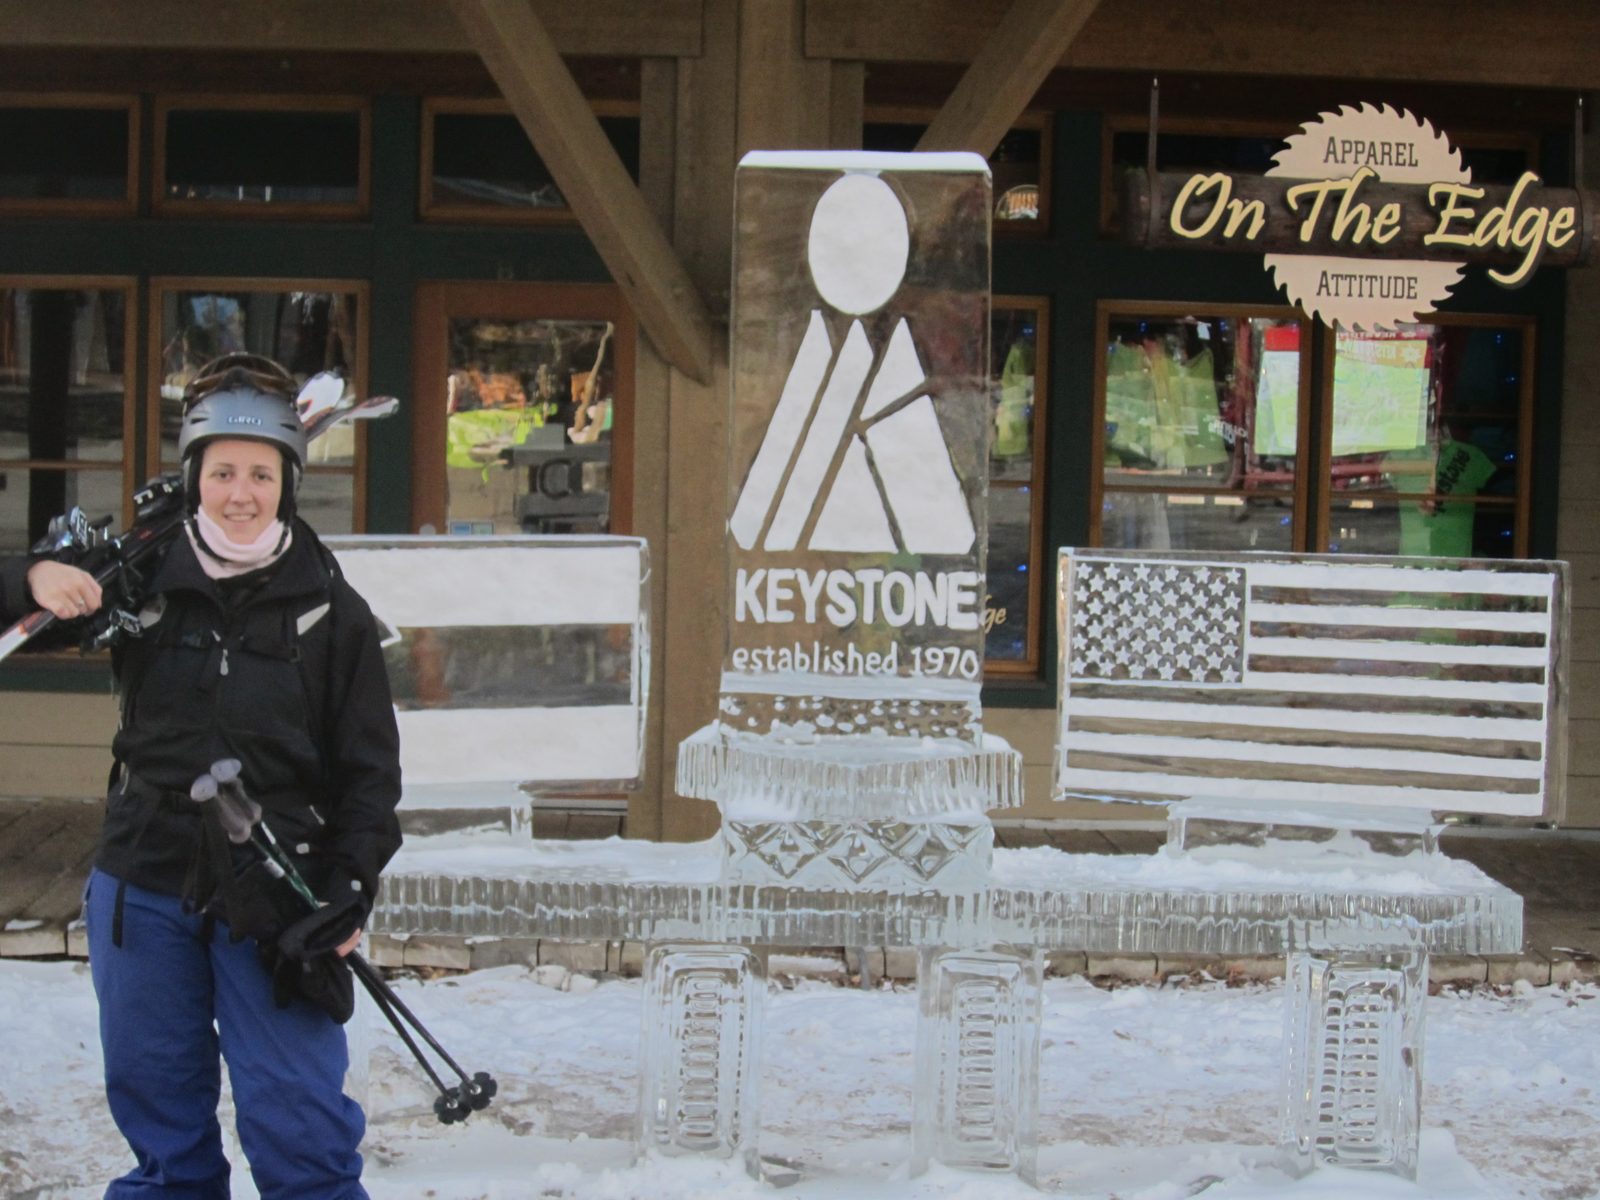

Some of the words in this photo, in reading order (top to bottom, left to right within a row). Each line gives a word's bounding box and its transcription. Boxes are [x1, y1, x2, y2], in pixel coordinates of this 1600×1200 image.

[1323, 136, 1419, 167] APPAREL
[1170, 172, 1266, 240] On
[1287, 166, 1401, 244] The
[1423, 171, 1576, 285] Edge
[1316, 270, 1418, 299] ATTITUDE
[735, 568, 979, 630] KEYSTONE
[731, 640, 898, 676] established
[910, 646, 980, 679] 1970
